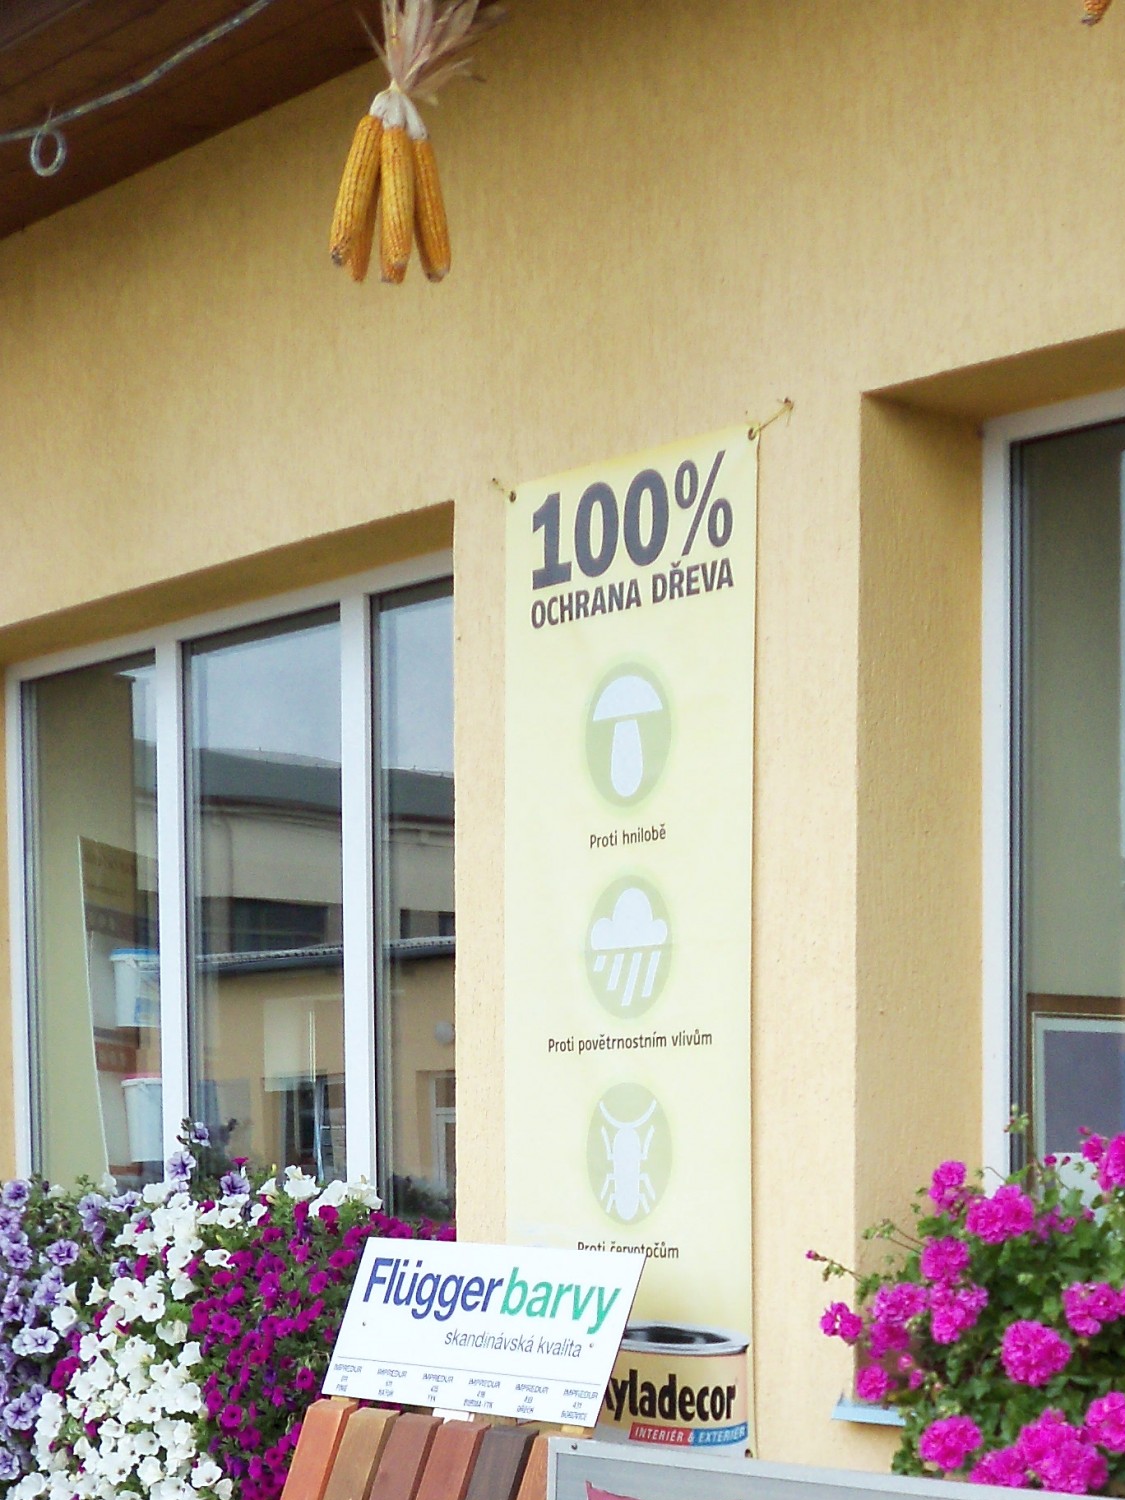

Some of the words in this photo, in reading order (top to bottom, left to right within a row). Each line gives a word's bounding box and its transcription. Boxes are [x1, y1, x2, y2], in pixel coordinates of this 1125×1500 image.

[532, 450, 733, 590] 100%
[531, 578, 641, 629] OCHRANA
[652, 557, 734, 603] DŘEVA
[590, 828, 618, 849] Proti
[622, 823, 666, 845] hnilobě
[548, 1037, 574, 1053] Proti
[578, 1031, 667, 1055] povětrnostním
[671, 1028, 712, 1047] vlivům
[445, 1330, 532, 1353] skandinávská
[538, 1335, 582, 1358] kvalita
[635, 1426, 684, 1442] INTERIÉR
